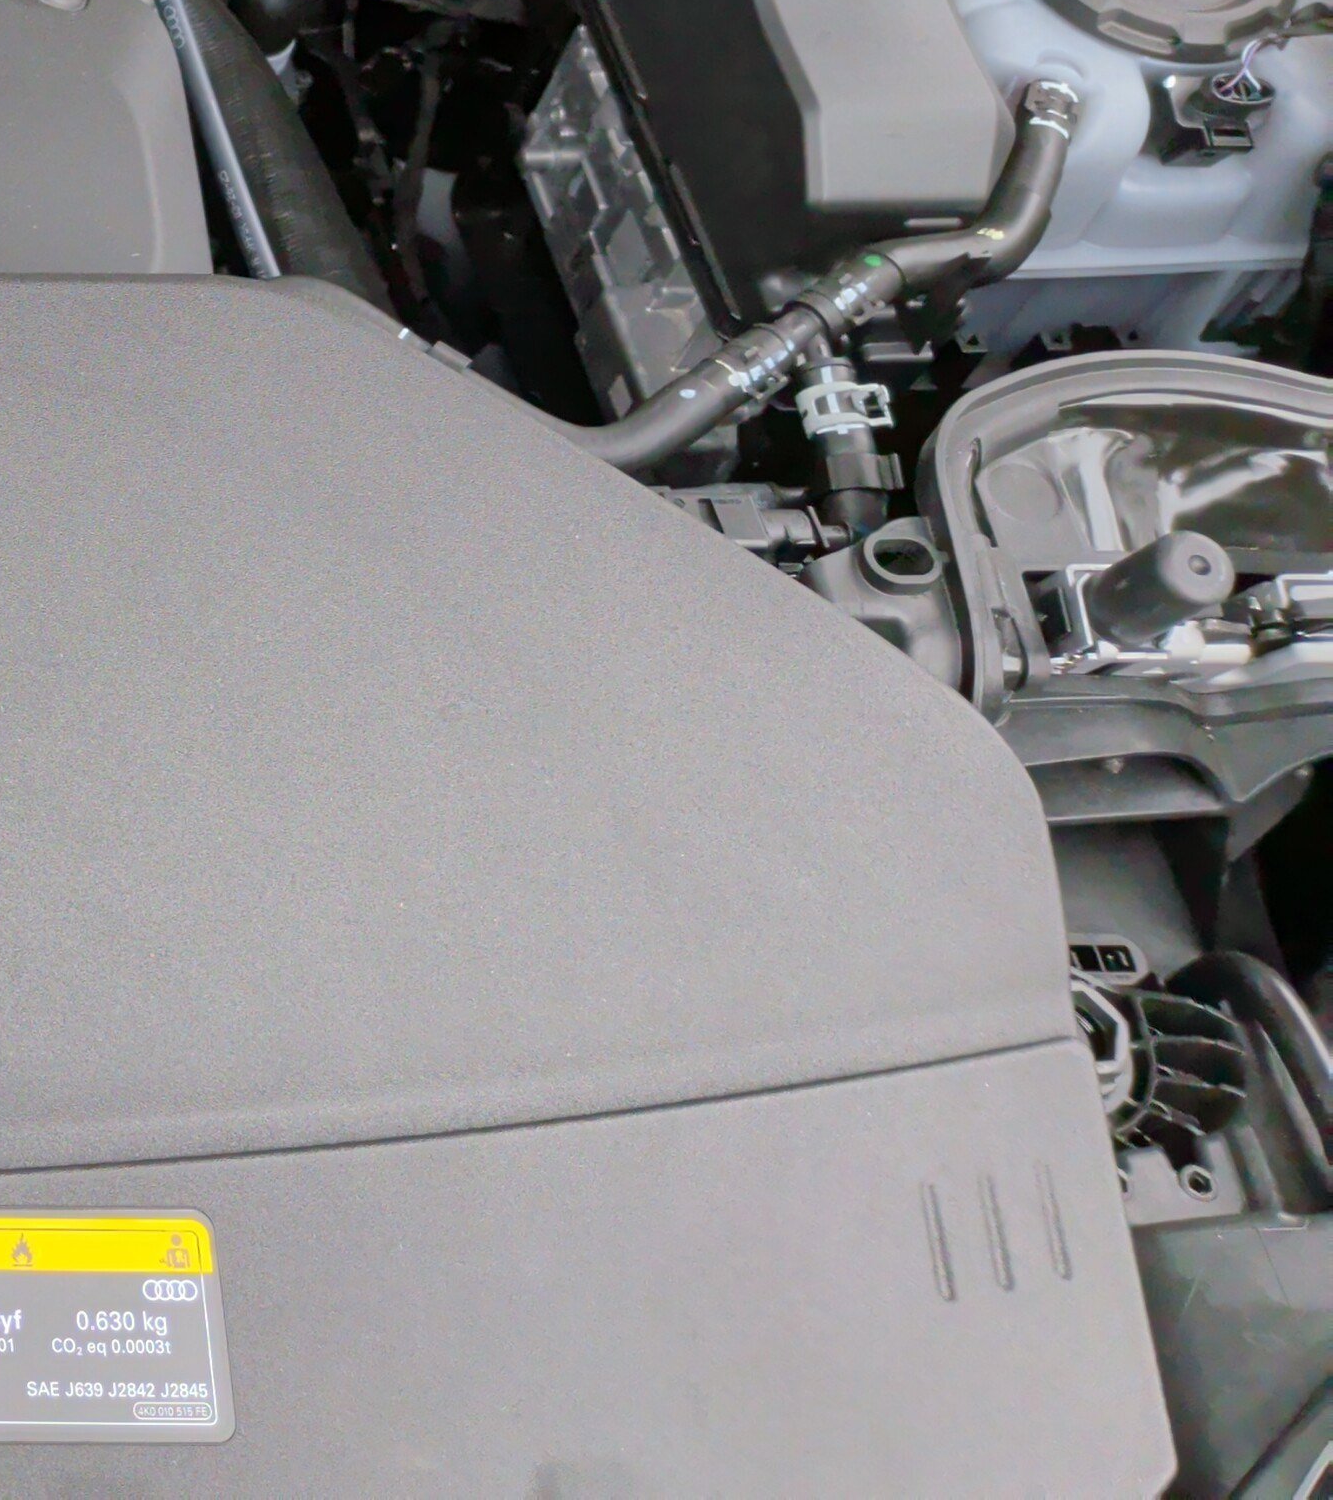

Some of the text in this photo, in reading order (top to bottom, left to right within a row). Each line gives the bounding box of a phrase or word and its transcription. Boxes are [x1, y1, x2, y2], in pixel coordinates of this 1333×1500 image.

[76, 1311, 168, 1335] 0.630 kg
[87, 1342, 108, 1358] eq
[111, 1339, 172, 1355] 0.0003t
[27, 1382, 208, 1399] SAE J639 J2842 J2845
[158, 1406, 174, 1417] 010
